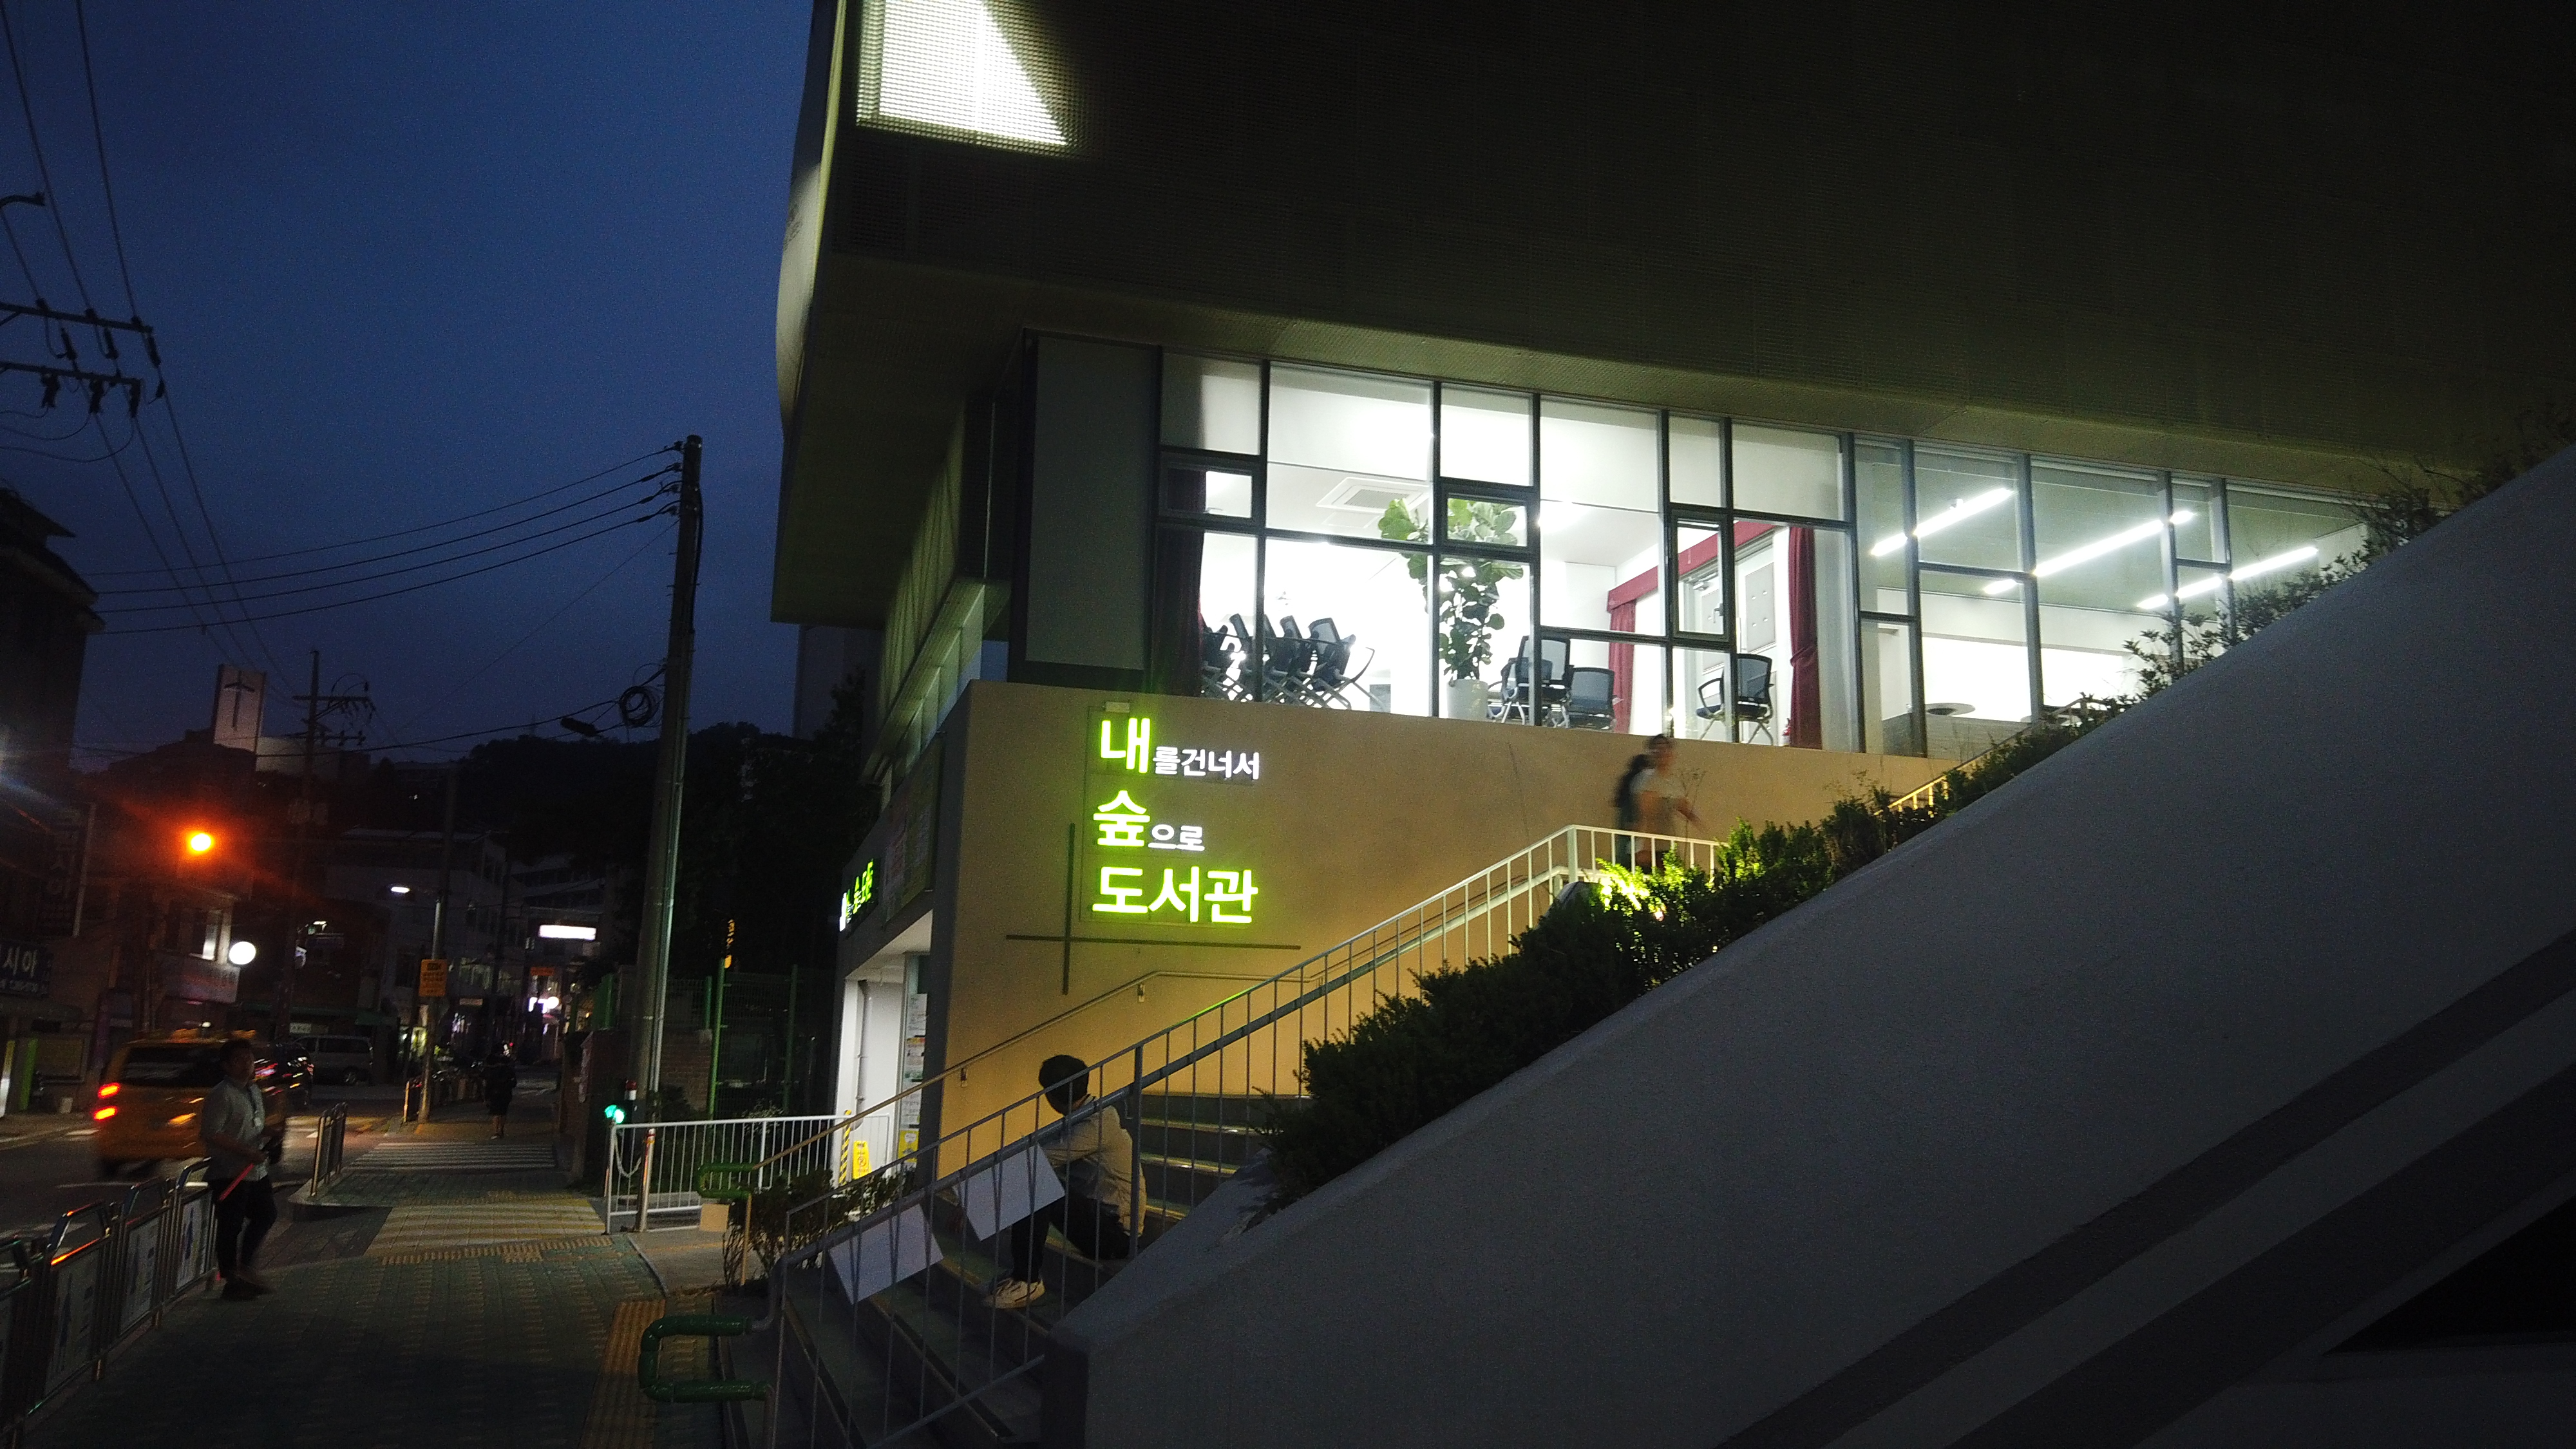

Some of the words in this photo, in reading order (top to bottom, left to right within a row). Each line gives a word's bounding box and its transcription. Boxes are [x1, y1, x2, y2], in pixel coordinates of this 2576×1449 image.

[1101, 717, 1260, 780] 내를건너서
[1093, 790, 1205, 851] 숲으로
[1092, 866, 1259, 923] 도서관
